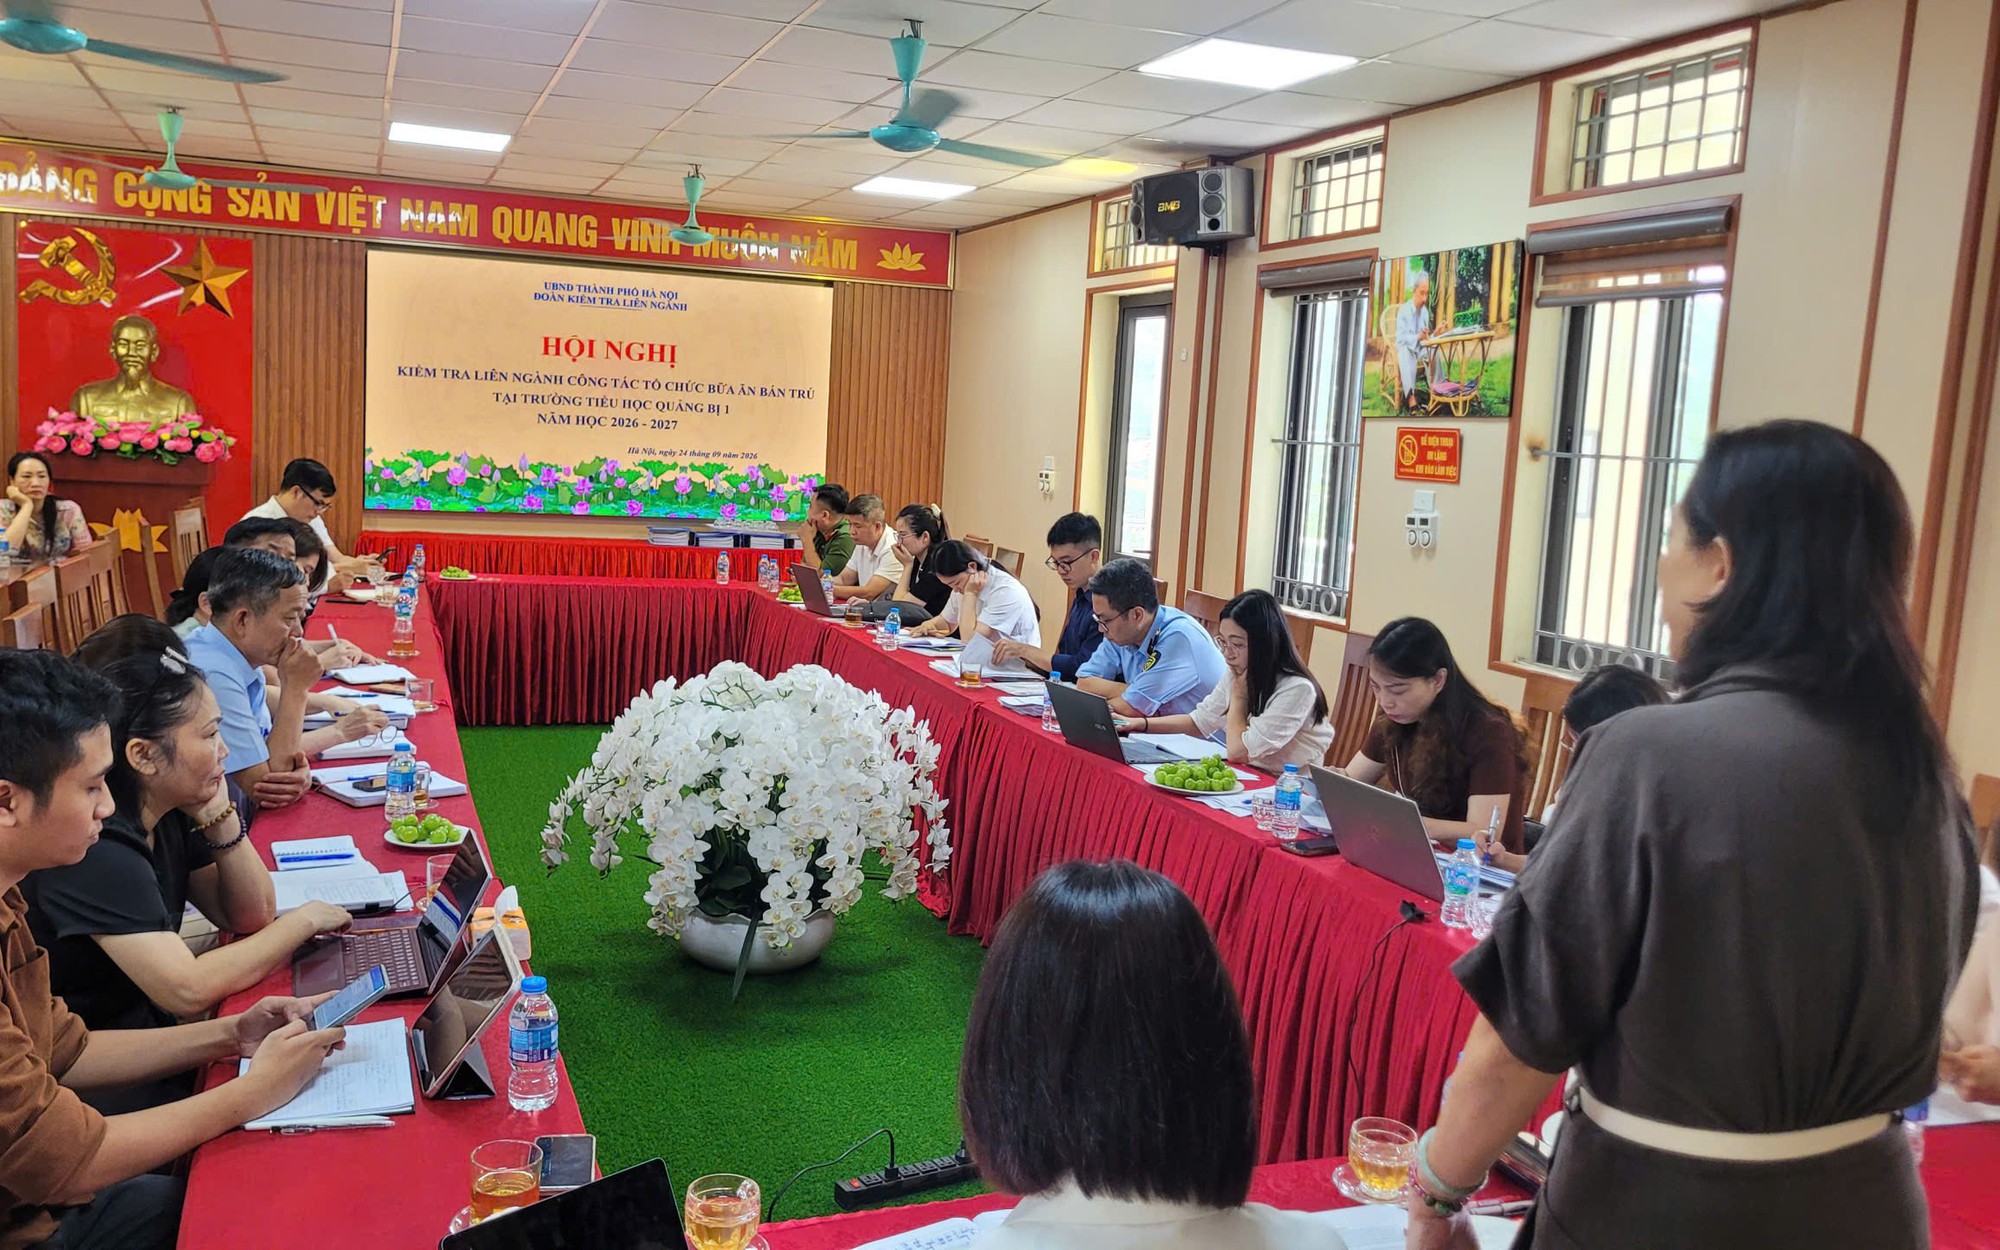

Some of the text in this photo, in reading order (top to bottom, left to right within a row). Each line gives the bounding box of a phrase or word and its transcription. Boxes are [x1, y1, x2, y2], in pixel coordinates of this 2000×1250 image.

[114, 165, 212, 217] CỘNG
[227, 172, 301, 223] SẢN
[314, 185, 387, 234] VIỆT
[401, 198, 478, 238] NAM
[492, 205, 598, 248] QUANG
[611, 217, 681, 255] VINH
[694, 223, 780, 264] MUÔN
[790, 229, 858, 271] NĂM
[534, 292, 688, 311] ĐOÀN KIỂM TRA LIÊN NGÀNH
[544, 281, 678, 301] UBND THÀNH PHỐ HÀ NỘI
[541, 334, 678, 369] HỘI NGHỊ
[397, 364, 815, 400] KIỂM TRA LIÊN NGÀNH CÔNG TÁC TỔ CHỨC BỮA ĂN BÁN TRÚ
[492, 392, 729, 416] TẠI TRƯỜNG TIỂU HỌC QUẢNG BỊ 1
[537, 412, 571, 425] NĂM
[575, 415, 607, 428] HỌC
[610, 417, 639, 428] 2026
[651, 419, 678, 430] 2027
[627, 446, 639, 454] Hà
[658, 448, 677, 457] ngày
[689, 449, 710, 459] tháng
[712, 450, 721, 458] 09
[722, 451, 739, 459] năm
[740, 452, 758, 460] 2026
